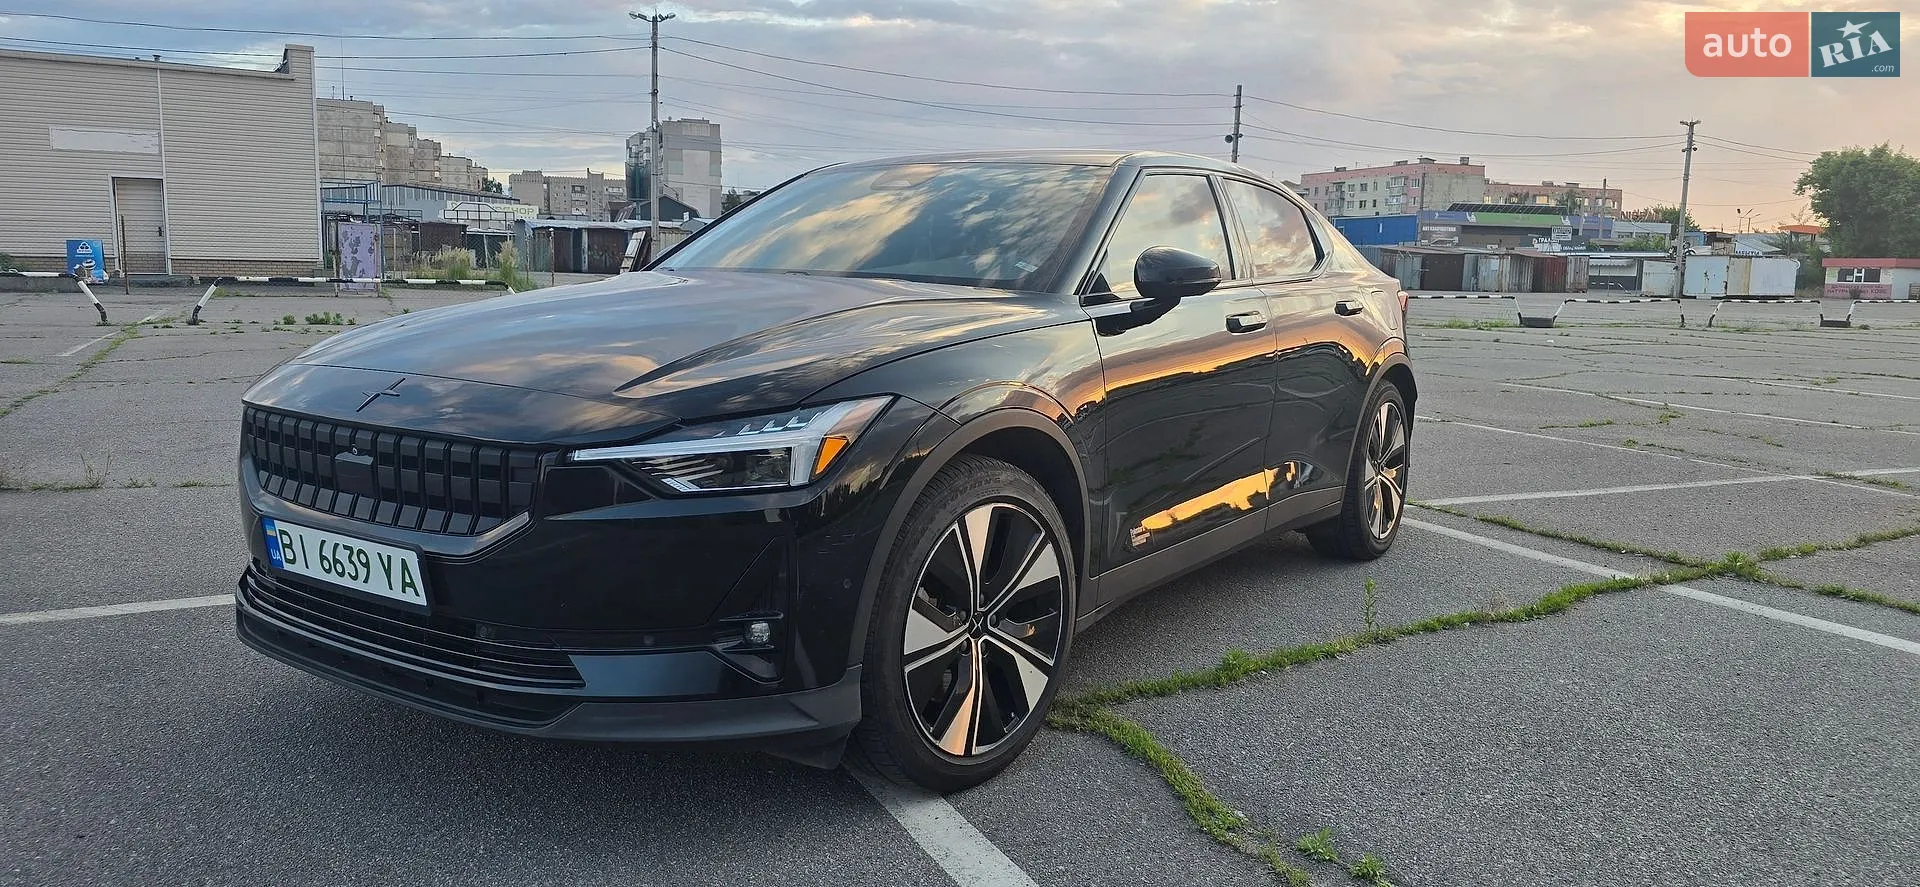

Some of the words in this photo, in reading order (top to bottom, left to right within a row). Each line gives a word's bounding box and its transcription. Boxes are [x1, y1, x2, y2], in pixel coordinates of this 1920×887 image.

[270, 549, 282, 561] UA
[278, 528, 309, 570] BI
[319, 539, 371, 584] 6639
[377, 551, 420, 598] YA
